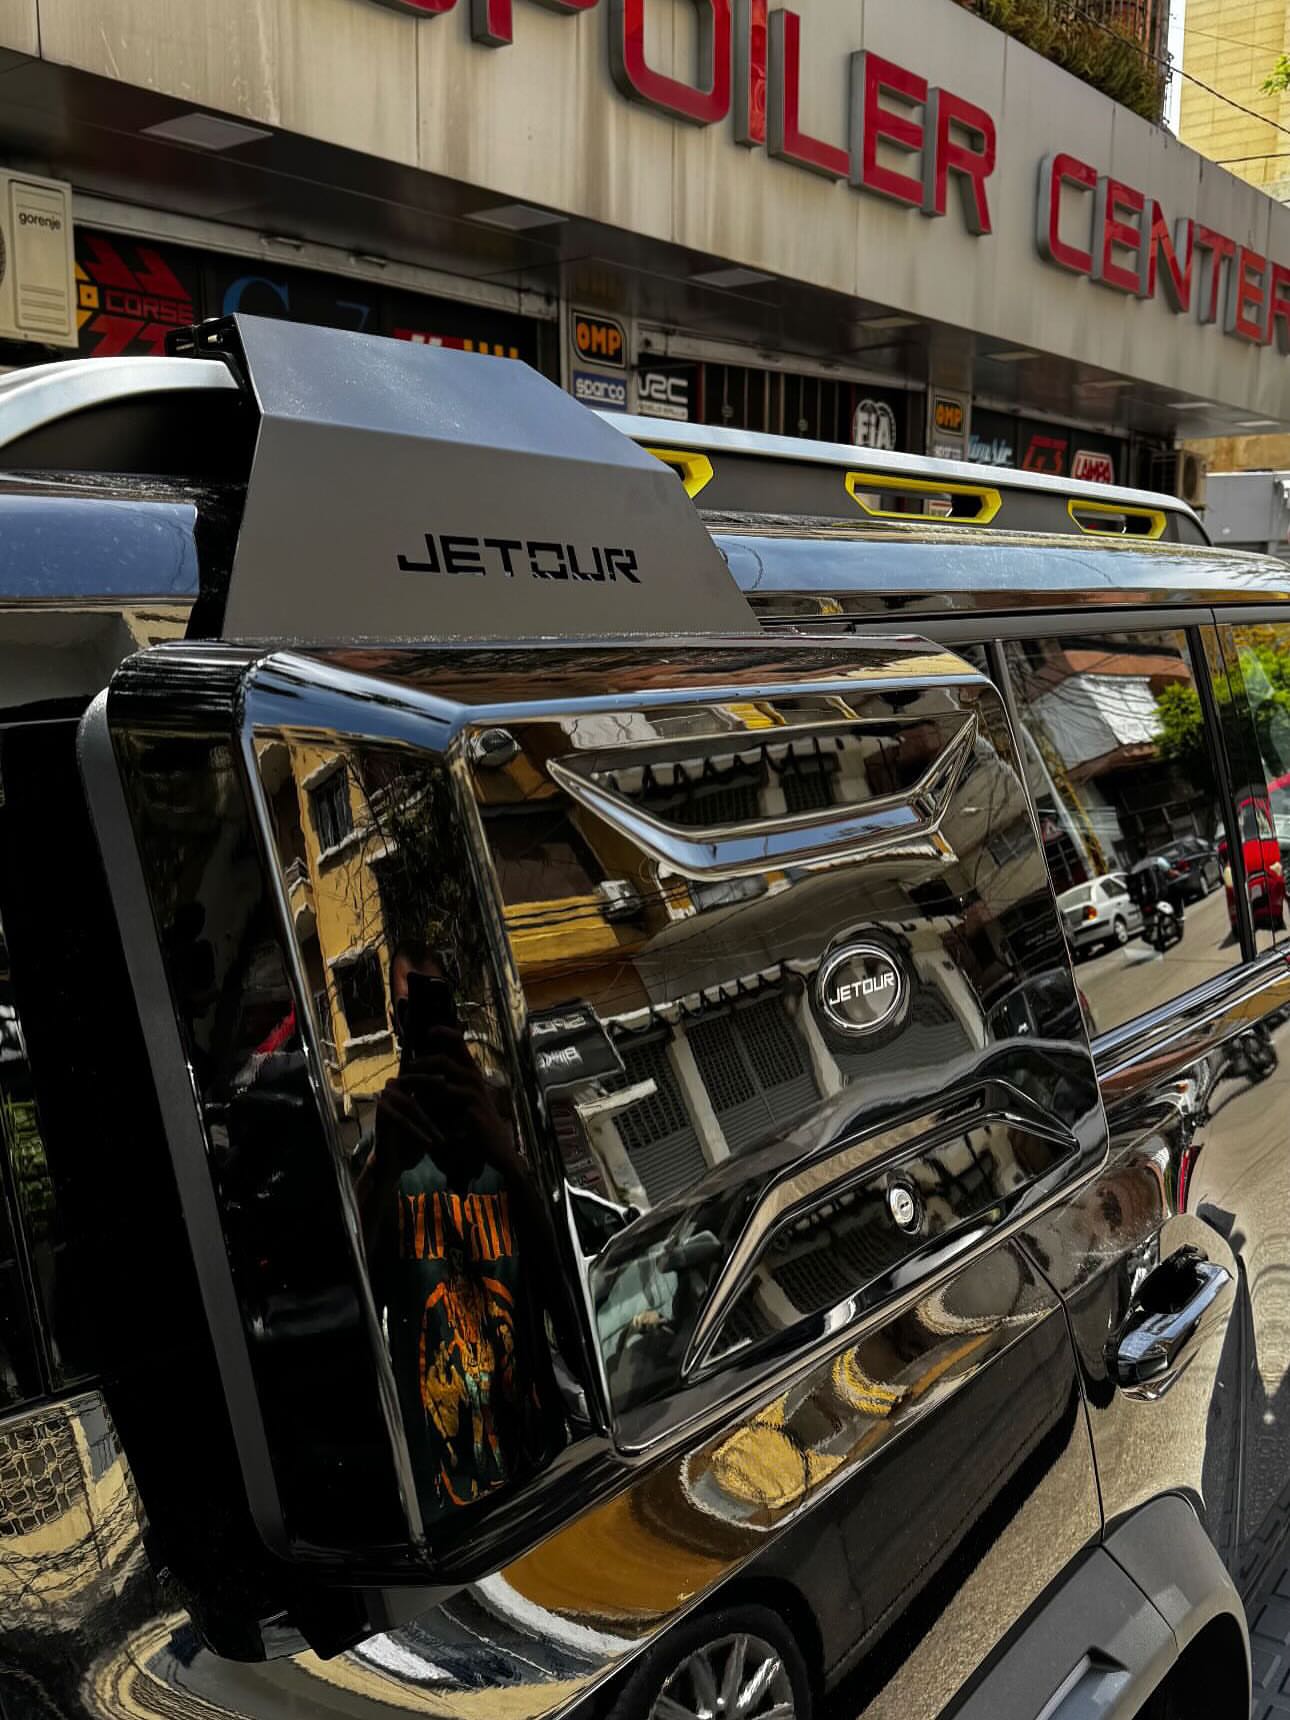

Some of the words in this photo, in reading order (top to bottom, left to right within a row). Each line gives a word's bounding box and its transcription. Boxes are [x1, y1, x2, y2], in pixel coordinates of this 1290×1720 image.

[367, 0, 998, 237] OILER
[18, 210, 62, 231] gorenje
[104, 288, 194, 327] CORSE
[576, 321, 621, 357] OMP
[575, 377, 626, 402] sparco
[934, 403, 963, 430] OMP
[397, 533, 641, 584] JETOUR
[828, 971, 895, 1006] JETOUR
